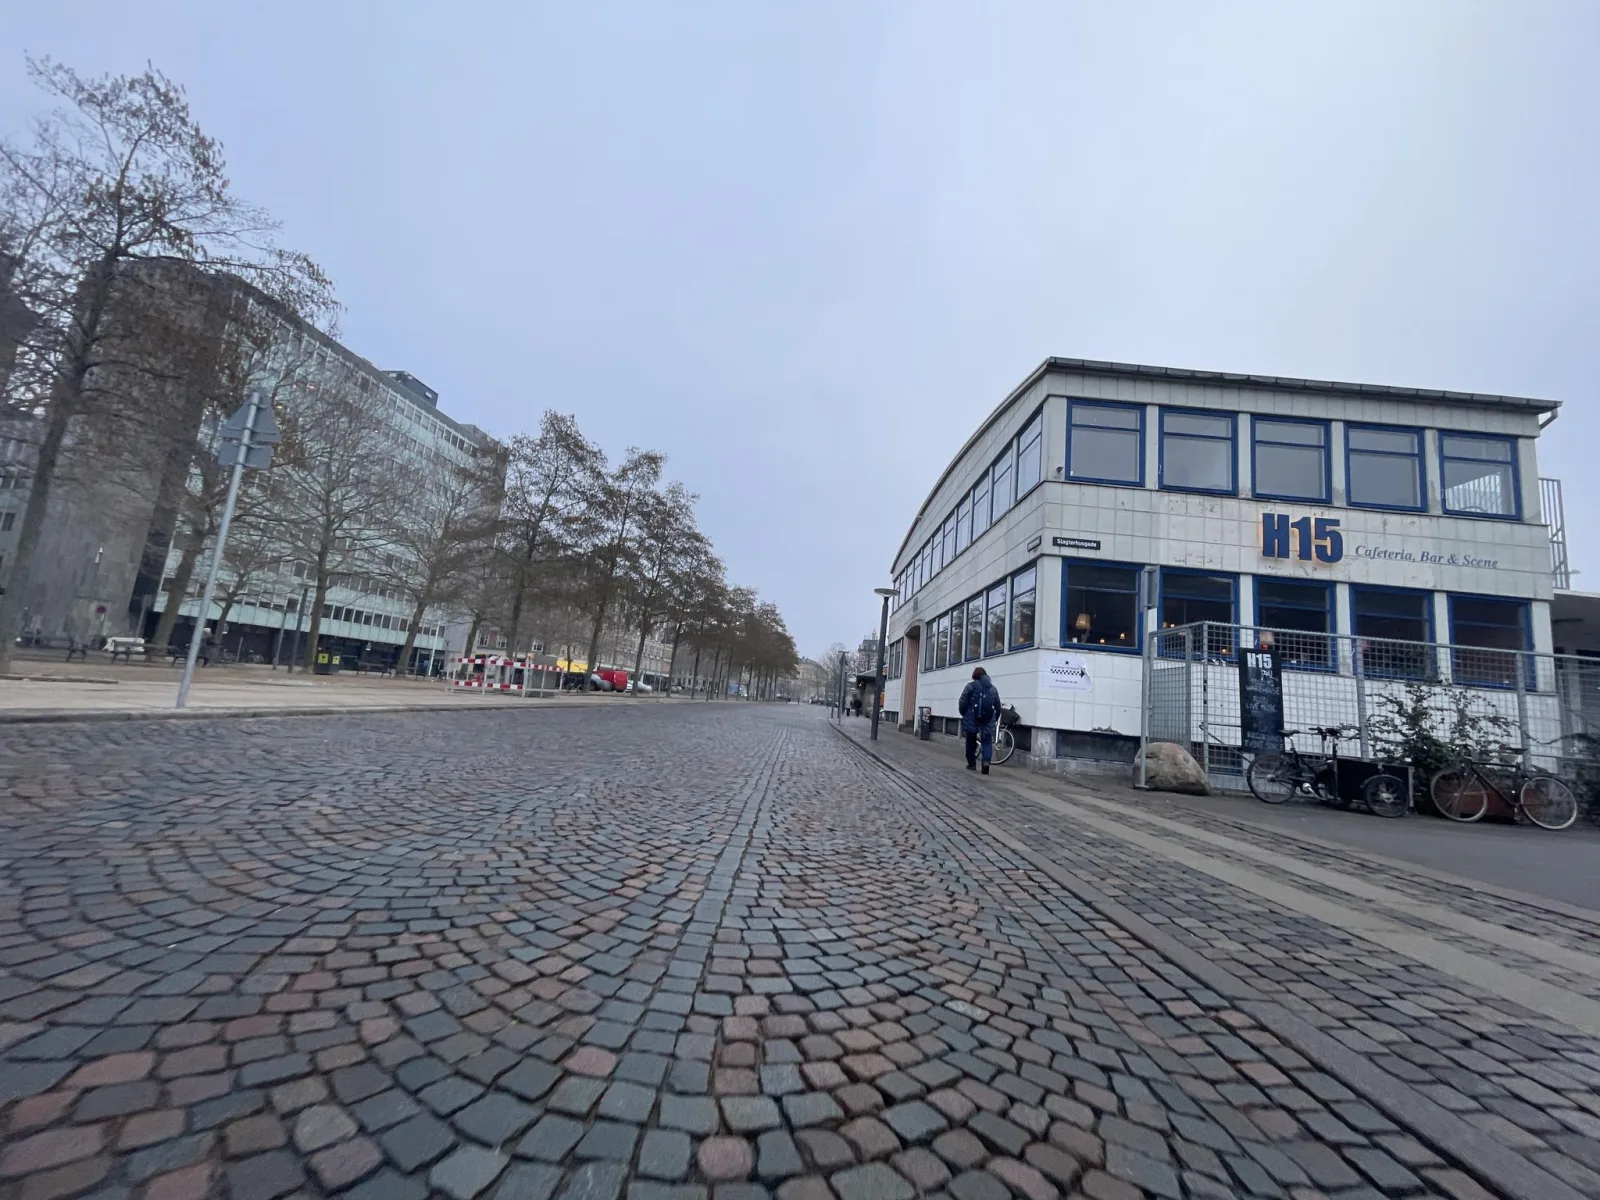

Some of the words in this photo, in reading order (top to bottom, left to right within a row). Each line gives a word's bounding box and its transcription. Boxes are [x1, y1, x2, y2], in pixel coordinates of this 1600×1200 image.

[1262, 513, 1343, 564] H15
[1354, 545, 1417, 563] Cafeteria,
[1419, 551, 1444, 563] Bar
[1446, 553, 1458, 564] &
[1462, 554, 1499, 569] Scene
[1246, 652, 1272, 669] H15
